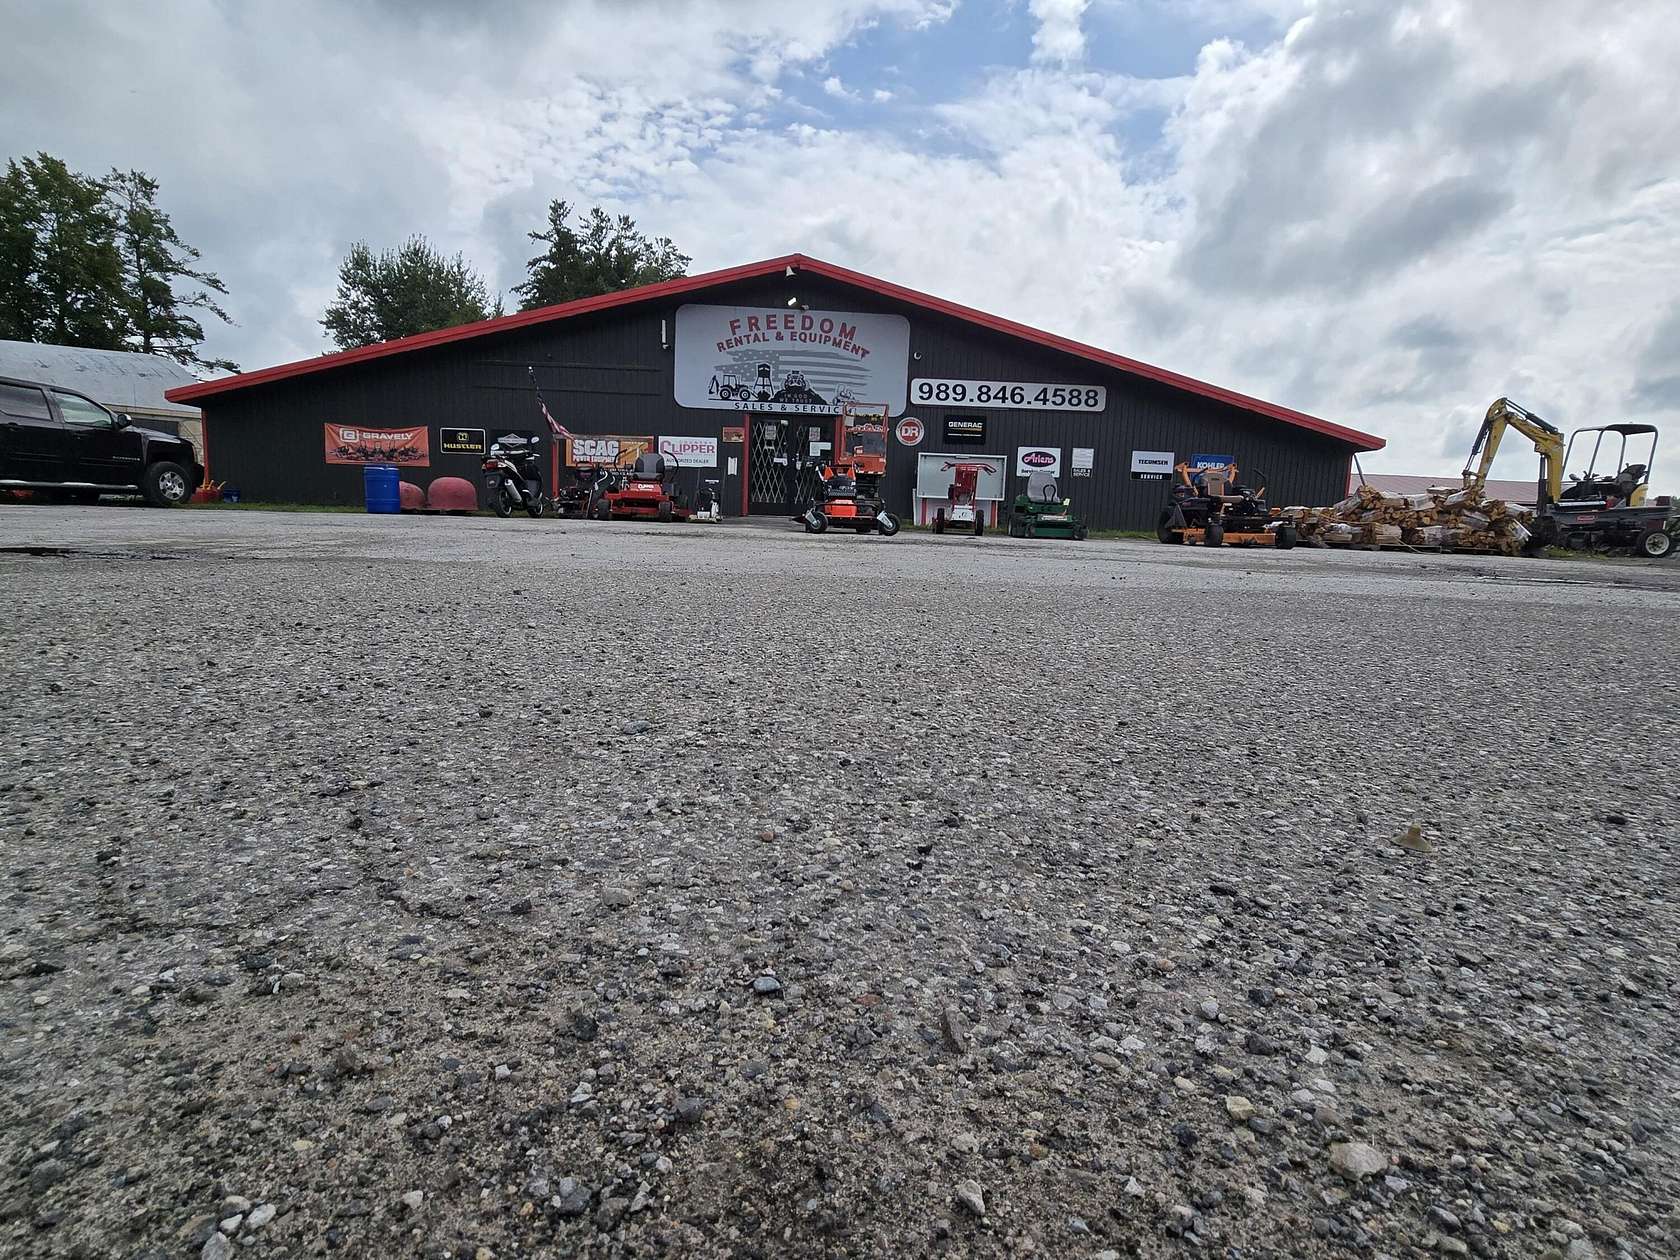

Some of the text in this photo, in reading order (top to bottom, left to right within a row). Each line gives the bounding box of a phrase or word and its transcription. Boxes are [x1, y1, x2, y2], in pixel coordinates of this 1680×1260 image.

[729, 313, 857, 341] FREEDOM
[716, 331, 870, 360] RENTAL & EQUIPMENT
[918, 382, 1099, 408] 989.846.4588
[734, 402, 773, 411] SALES
[363, 432, 413, 440] GRAVELY
[901, 426, 919, 437] DR
[573, 439, 619, 456] SCAG
[660, 440, 715, 454] CLIPPER
[1023, 453, 1054, 464] Ariens
